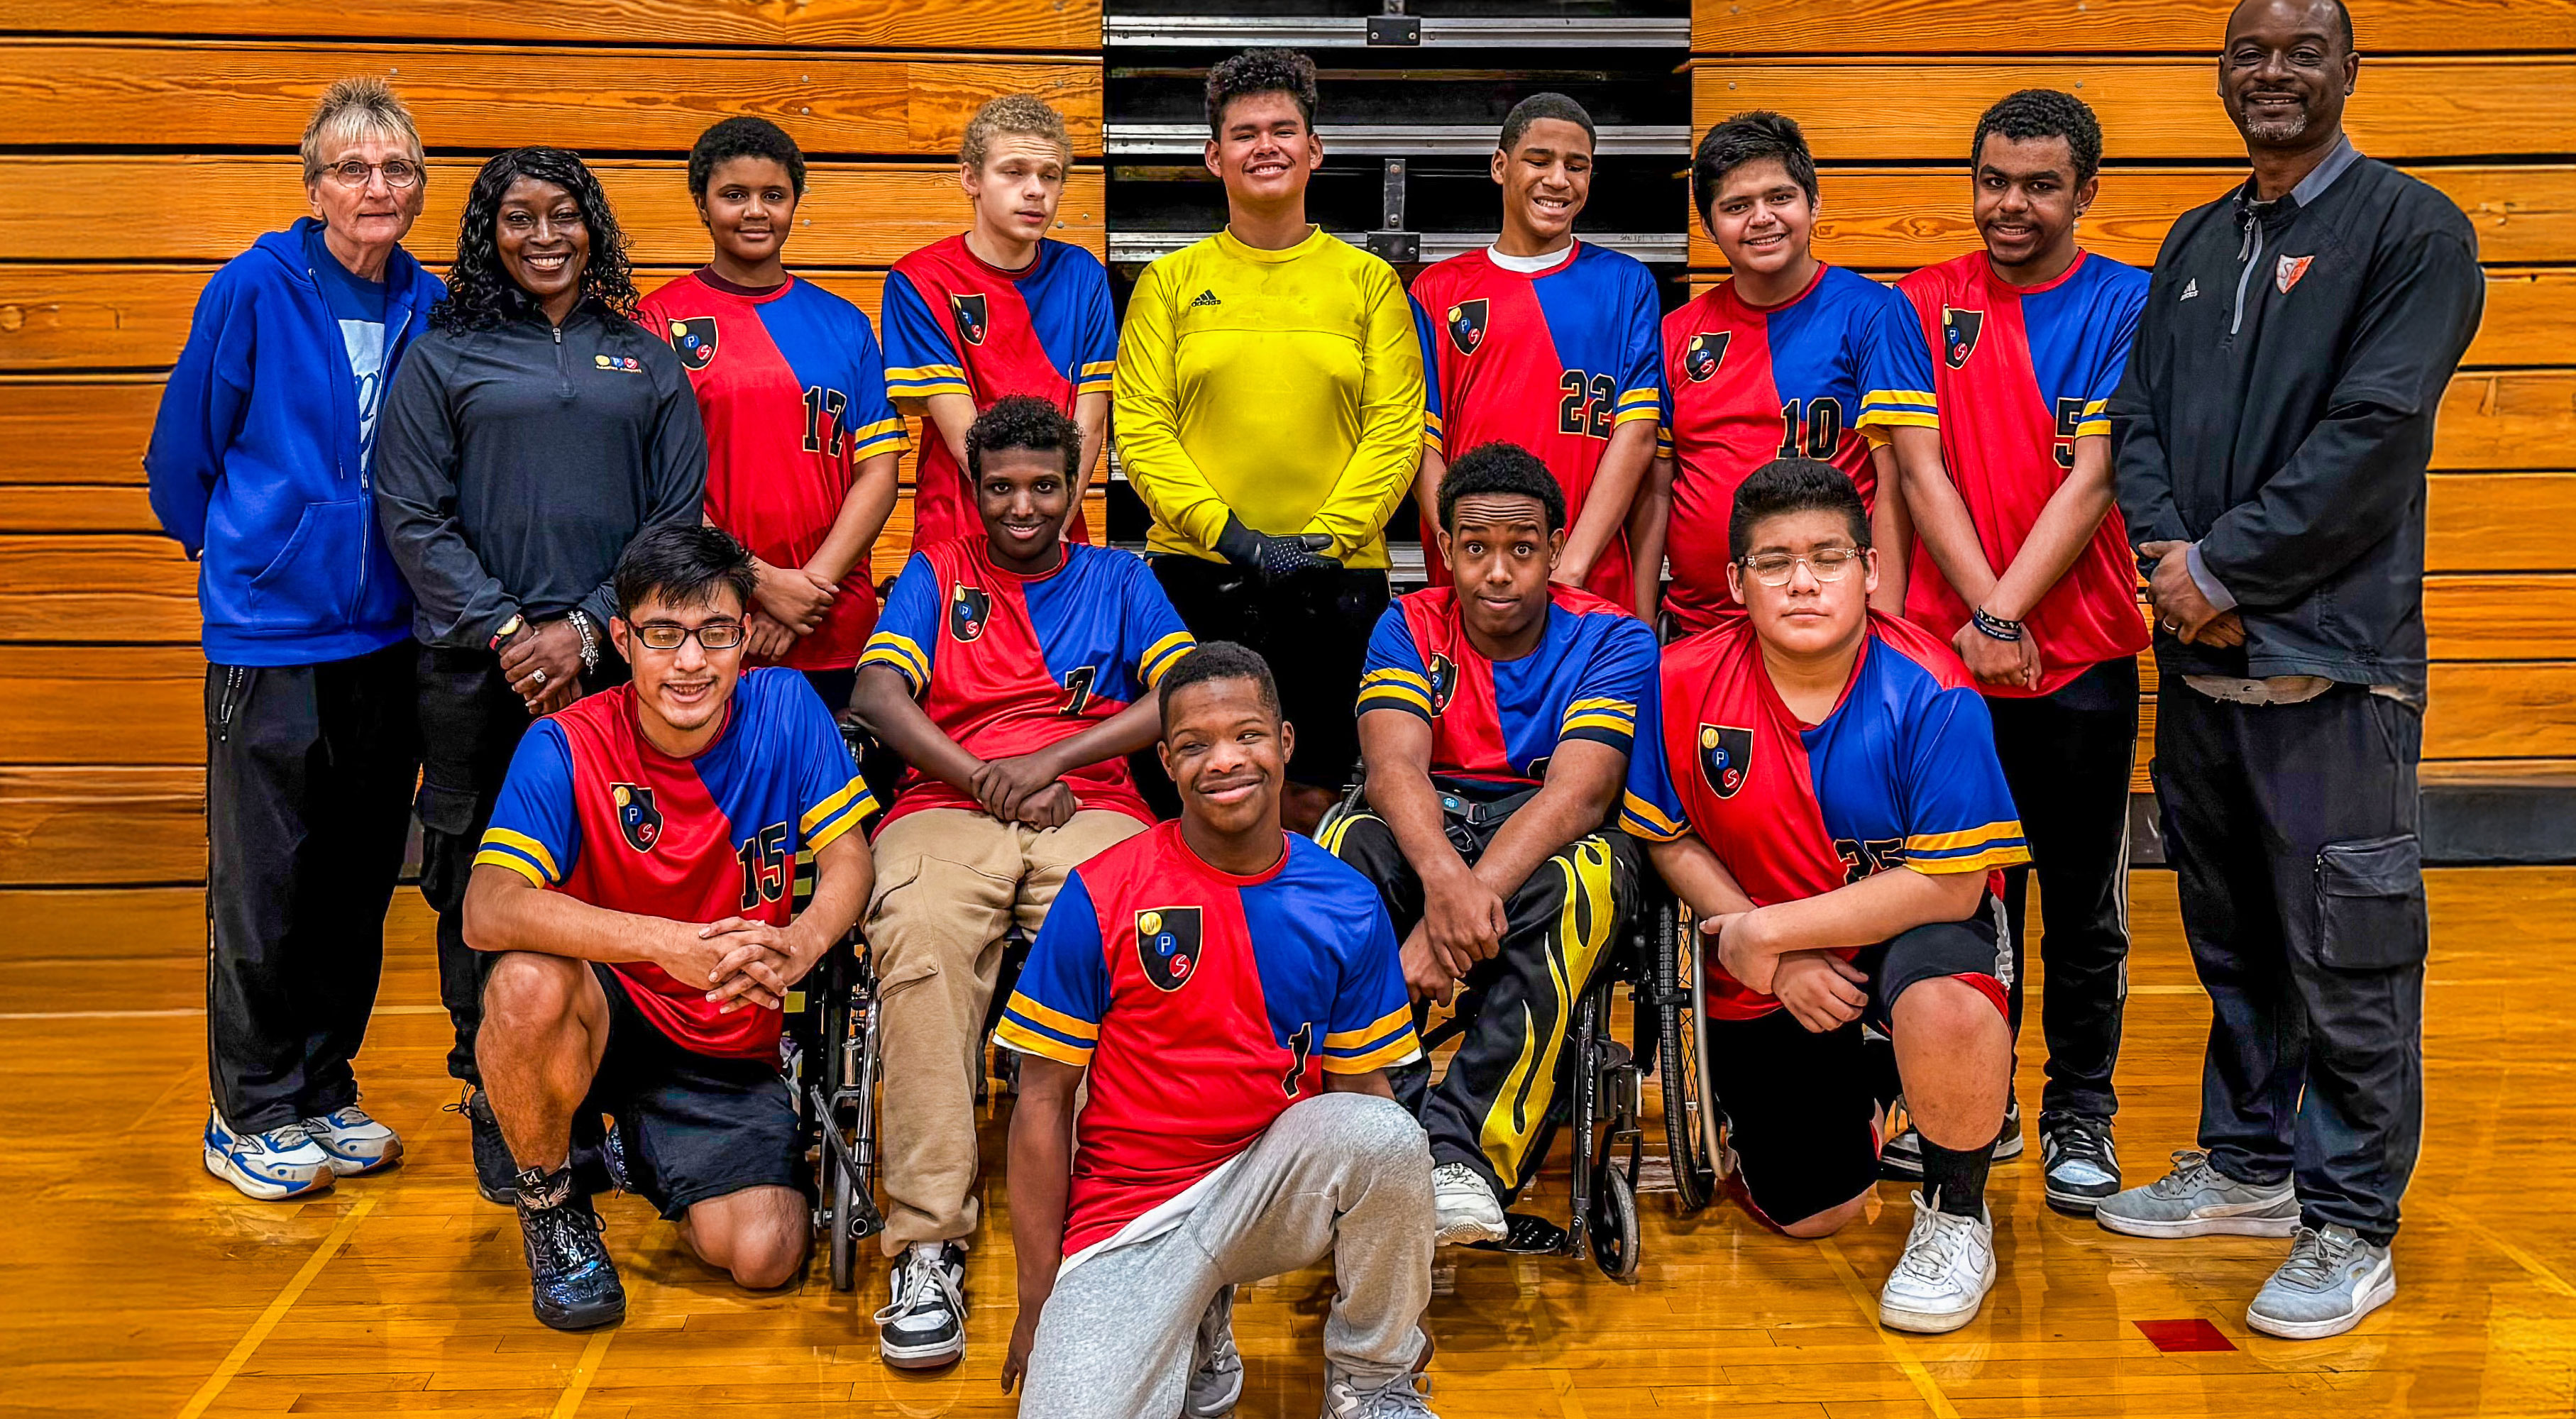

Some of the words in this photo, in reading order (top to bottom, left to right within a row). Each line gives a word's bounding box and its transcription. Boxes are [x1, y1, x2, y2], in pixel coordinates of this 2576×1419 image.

[595, 355, 638, 369] PS
[671, 321, 712, 360] PS
[1691, 336, 1715, 374] PS
[802, 385, 847, 458] 17
[1558, 369, 1616, 440] 22
[1776, 397, 1842, 460] 10
[2053, 397, 2085, 468] 5
[1057, 666, 1096, 716] 7
[1702, 728, 1740, 788] MPS
[736, 821, 787, 912] 15
[1139, 912, 1191, 978] MPS
[1282, 1022, 1311, 1100] 1
